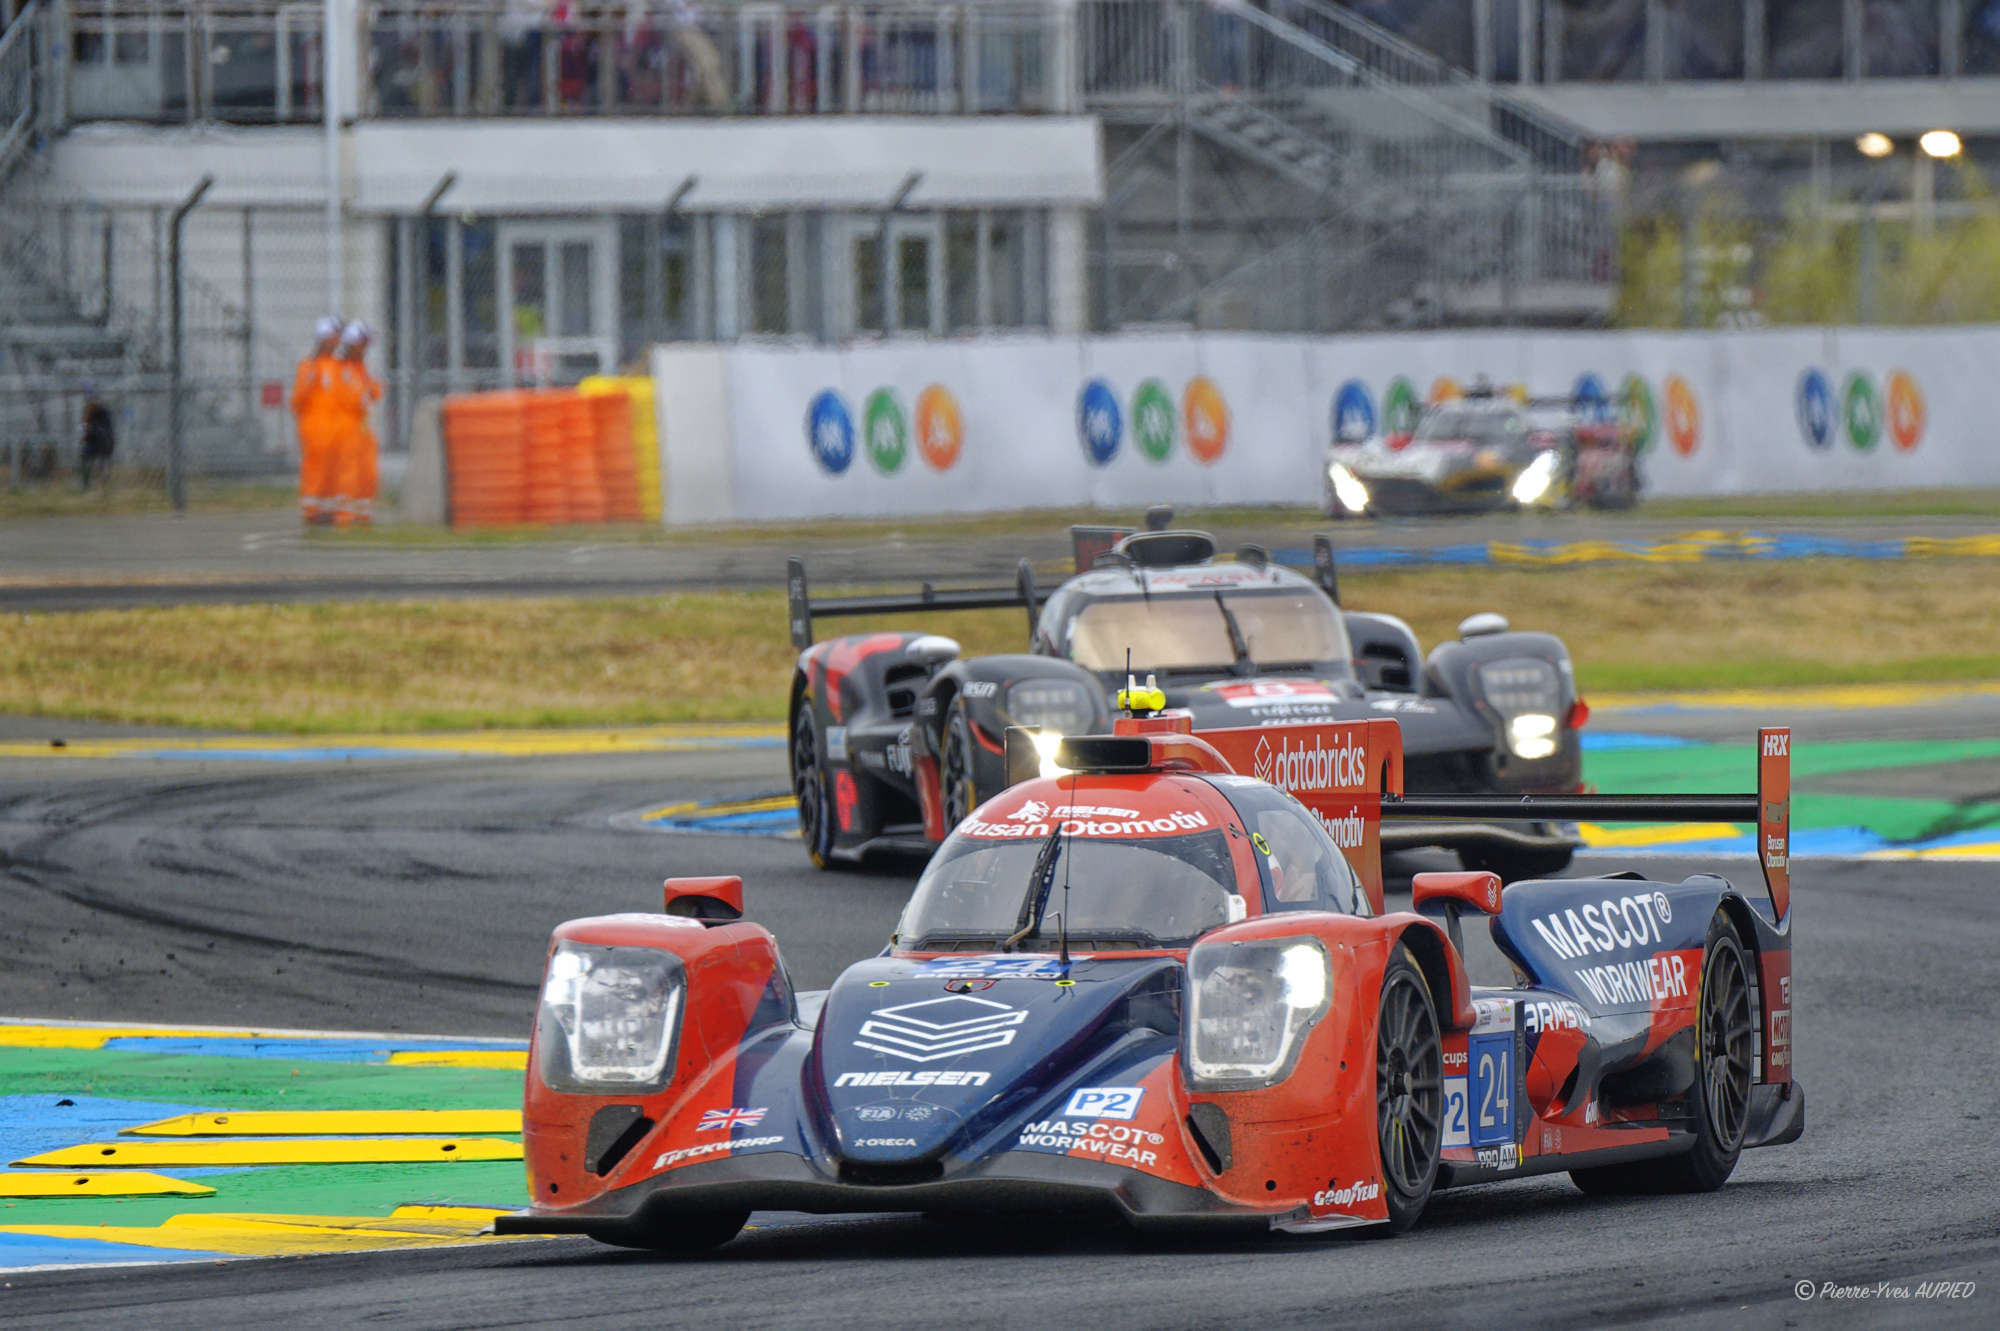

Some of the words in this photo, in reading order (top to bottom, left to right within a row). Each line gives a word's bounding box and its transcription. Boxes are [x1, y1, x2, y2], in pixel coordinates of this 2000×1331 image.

[1763, 734, 1789, 757] HRX
[1275, 732, 1366, 792] databricks
[1060, 810, 1209, 837] Otomotiv
[1311, 805, 1365, 848] omotiv
[1531, 891, 1673, 960] MASCOT®
[932, 959, 1054, 974] 24
[1574, 955, 1689, 1006] WORKWEAR
[1442, 1052, 1469, 1068] cups
[833, 1071, 992, 1088] NIELSEN
[1479, 1051, 1510, 1128] 24
[1075, 1092, 1132, 1112] P2
[866, 1138, 918, 1148] ORECA
[1022, 1120, 1165, 1145] MASCOT®
[1018, 1134, 1158, 1167] WORKWEAR
[1478, 1149, 1499, 1169] PRO
[1500, 1144, 1516, 1167] AM
